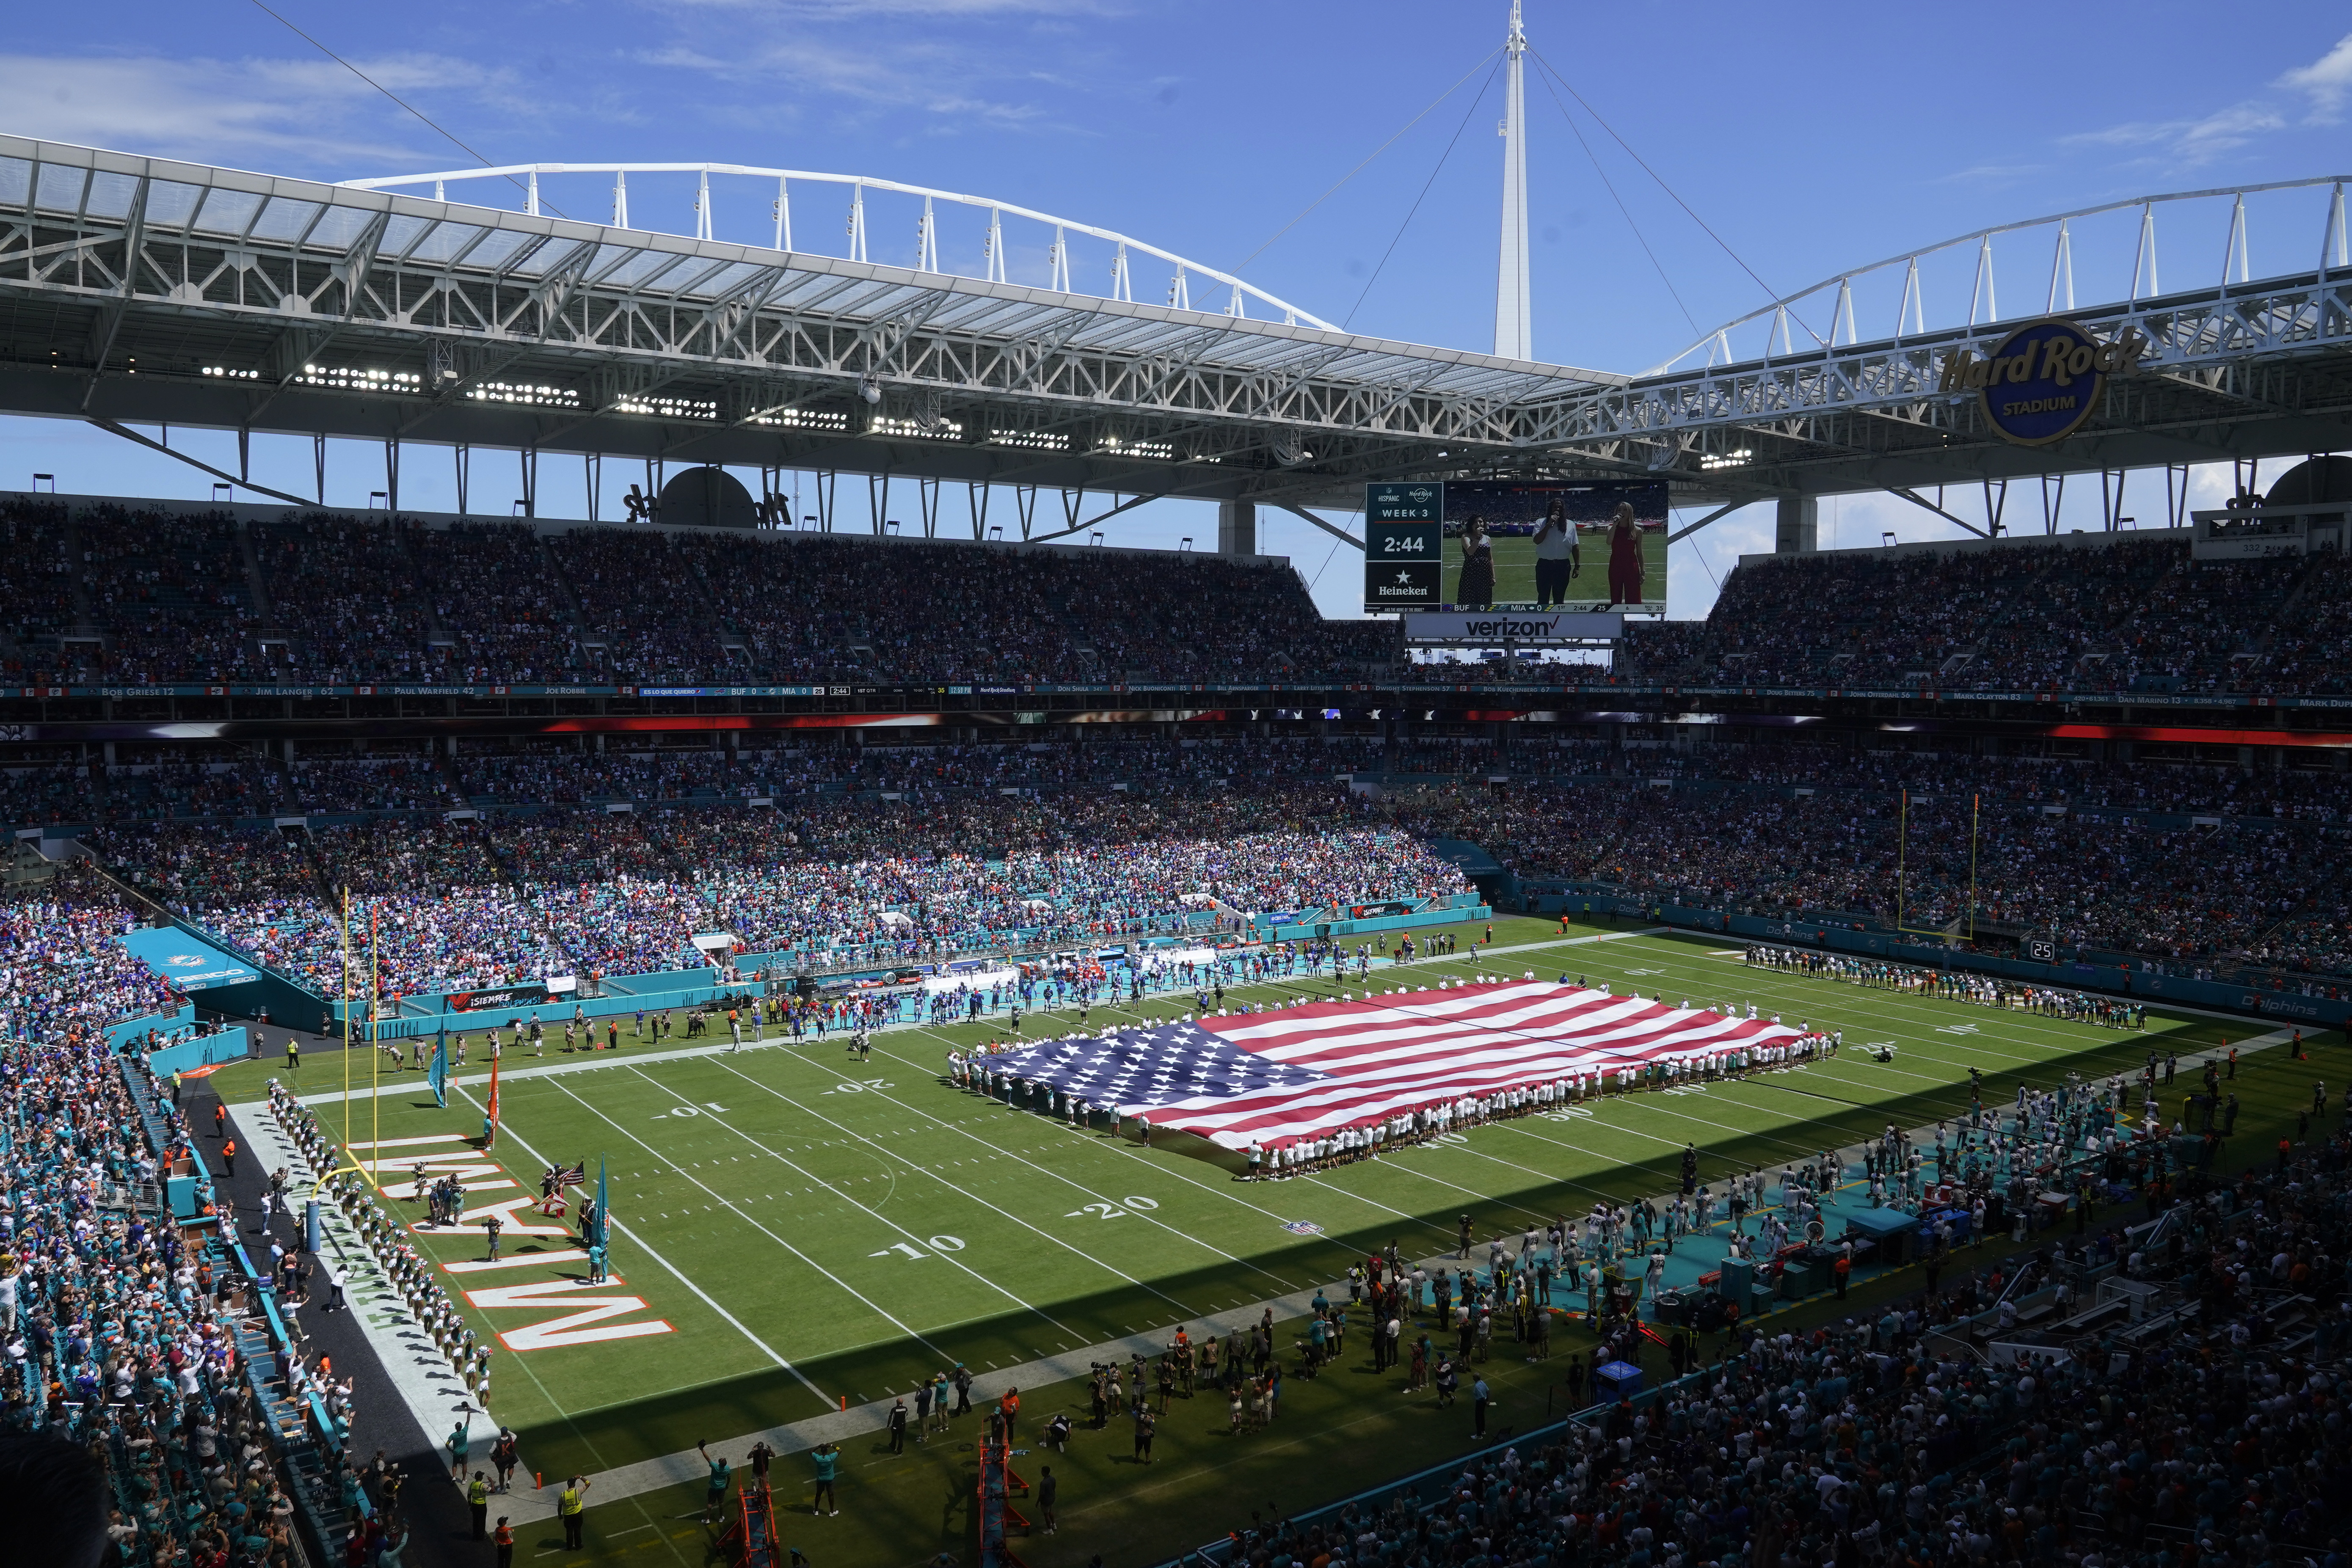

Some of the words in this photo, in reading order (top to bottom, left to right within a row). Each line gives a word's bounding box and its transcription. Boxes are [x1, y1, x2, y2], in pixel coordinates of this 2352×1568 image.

[1938, 339, 2040, 392] Hard
[2040, 325, 2149, 386] Rock
[2003, 396, 2076, 416] STADIUM
[1382, 509, 1416, 517] WEEK
[1422, 509, 1428, 517] 3
[1384, 537, 1424, 552] 2:44
[1379, 586, 1428, 595] Heineken
[1466, 617, 1549, 636] verizon
[102, 687, 125, 696] BOB
[126, 687, 160, 696] GRIESE
[163, 687, 174, 696] 12
[255, 687, 273, 695] JIM
[275, 687, 313, 695] LANGER
[320, 687, 334, 695] 62
[2034, 944, 2051, 957] 25
[175, 968, 245, 982] GEICO
[229, 975, 256, 984] GEICO
[470, 992, 513, 1007] ¡SIEMPRE
[1935, 1025, 1980, 1036] 10
[837, 1078, 895, 1093] 20
[671, 1102, 731, 1117] 10
[1083, 1196, 1159, 1220] 20
[1298, 1224, 1321, 1234] NFL
[340, 1134, 679, 1352] MIAMI
[890, 1235, 965, 1260] 10
[2002, 1308, 2010, 1318] 10
[501, 1442, 511, 1456] K
